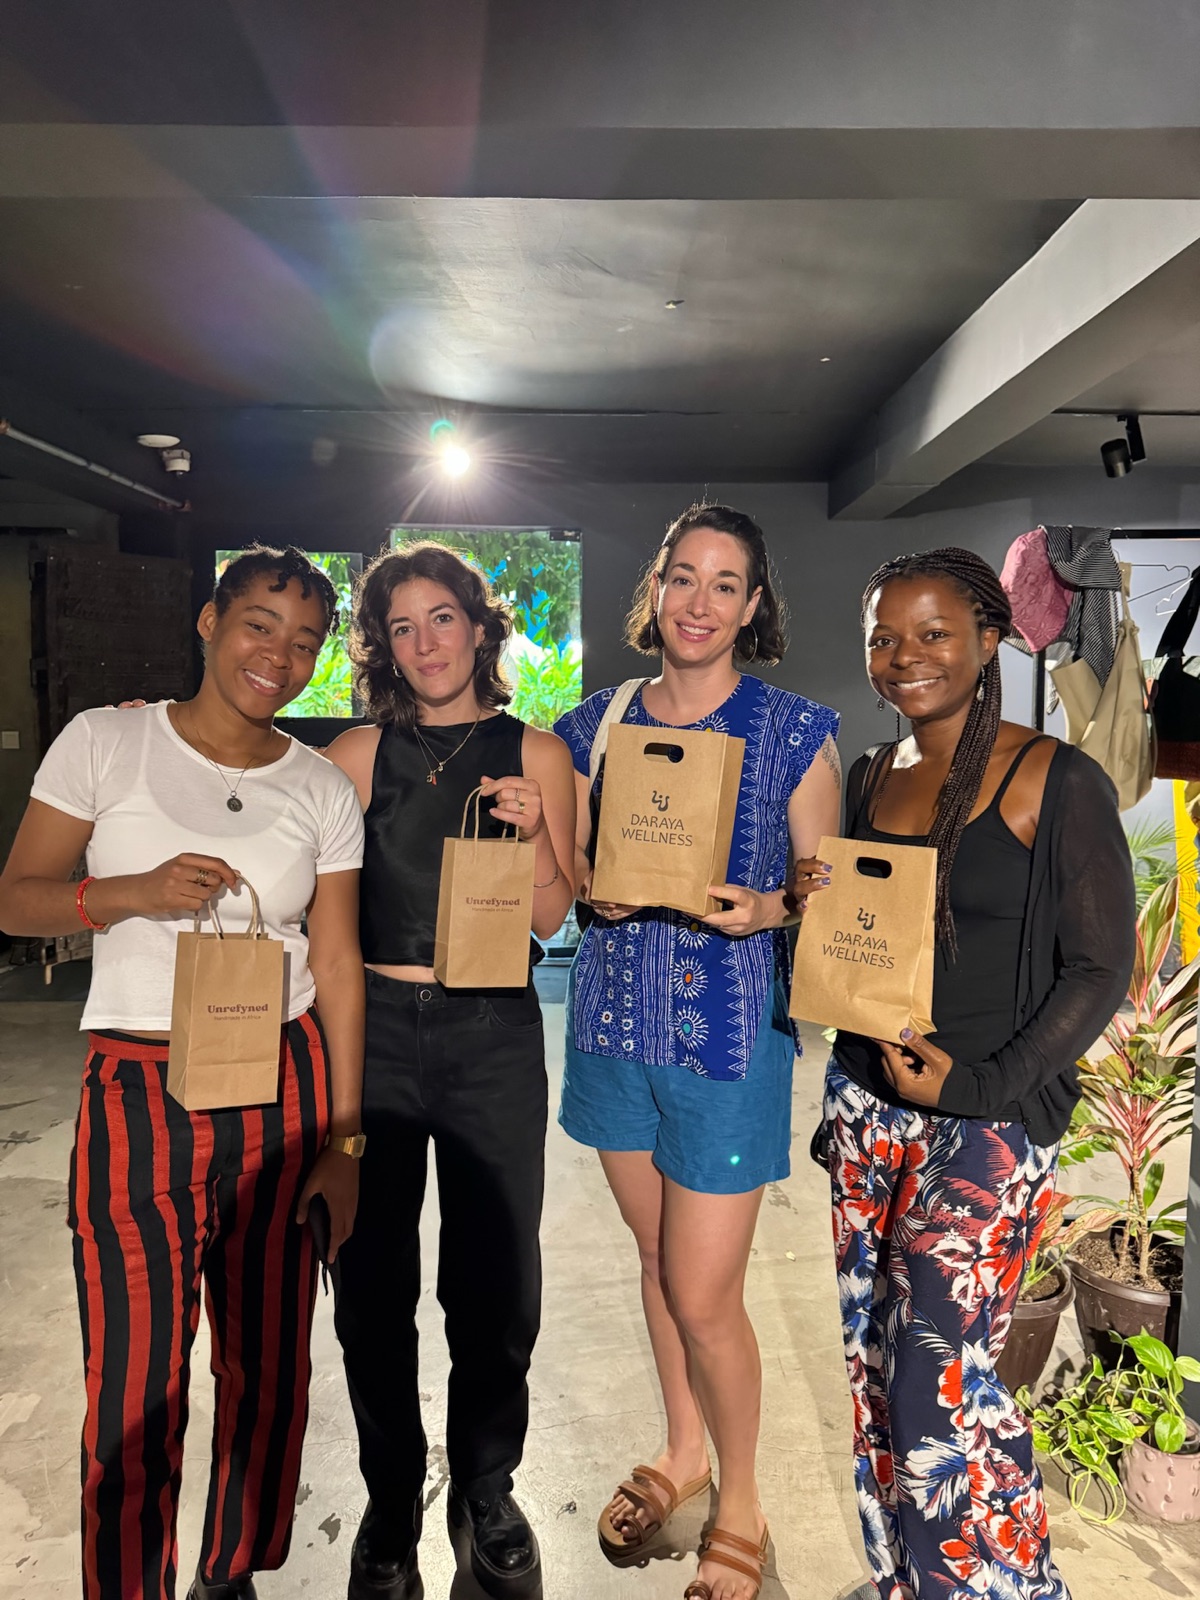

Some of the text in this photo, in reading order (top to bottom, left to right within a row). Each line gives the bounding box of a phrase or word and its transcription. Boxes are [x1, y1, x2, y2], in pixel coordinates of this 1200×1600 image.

[630, 813, 685, 831] DARAYA
[621, 827, 693, 847] WELLNESS
[465, 897, 520, 907] Unrefyned
[833, 930, 888, 952] DARAYA
[822, 943, 895, 970] WELLNESS
[207, 1003, 269, 1014] Unrefyned
